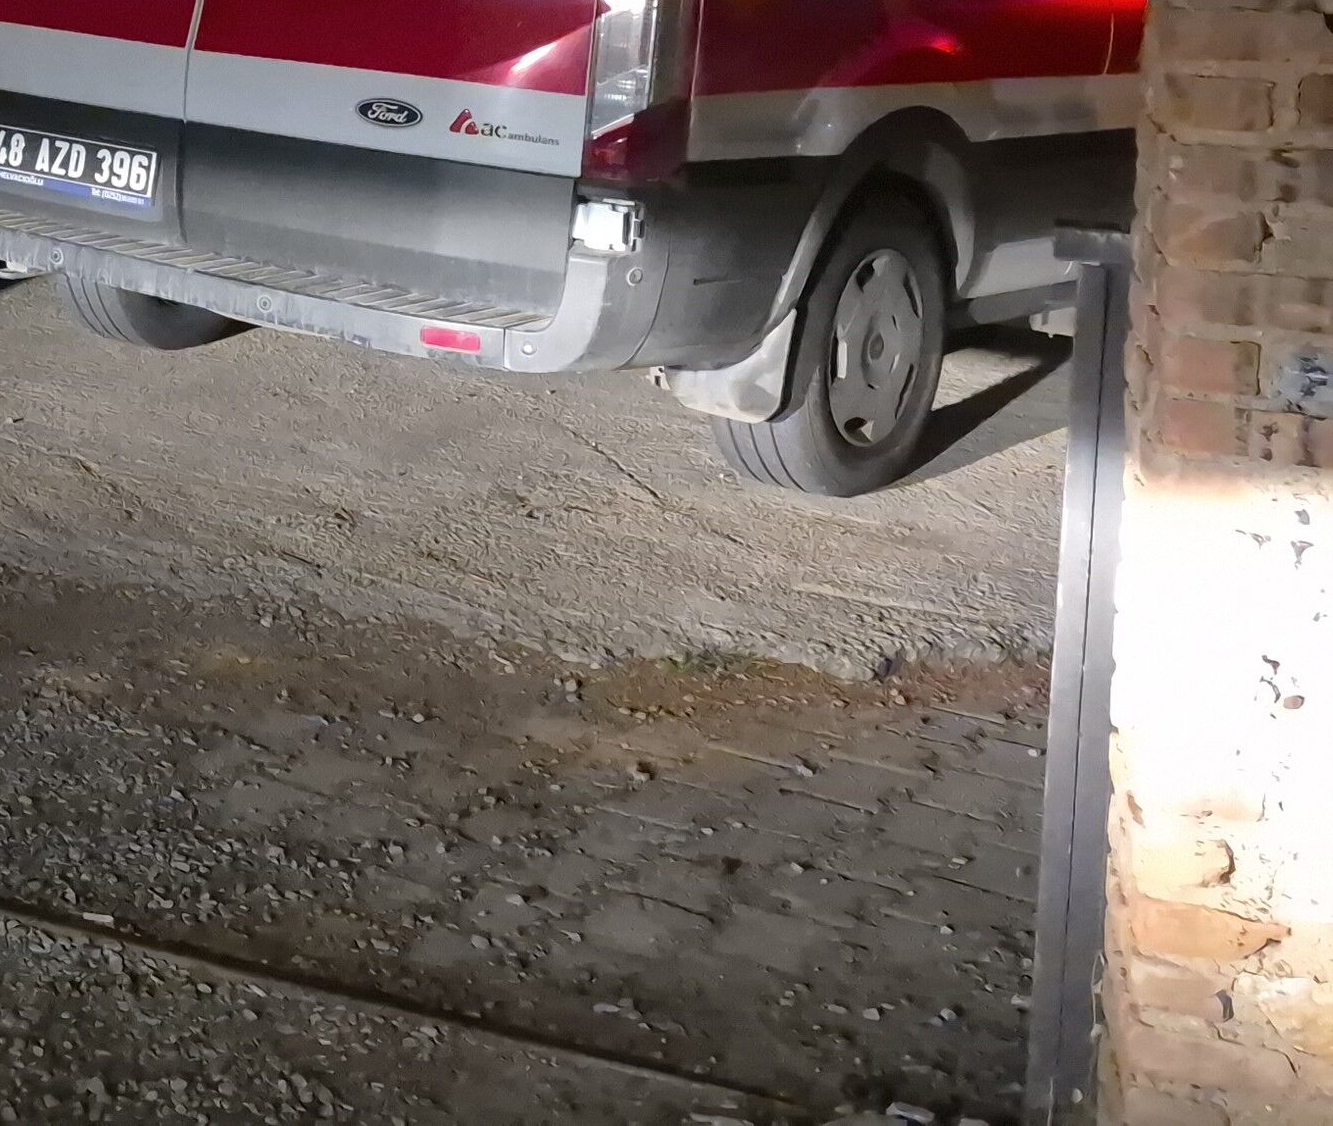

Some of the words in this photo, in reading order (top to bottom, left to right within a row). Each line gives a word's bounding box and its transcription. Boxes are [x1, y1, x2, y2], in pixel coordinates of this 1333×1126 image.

[367, 102, 409, 124] Ford
[507, 133, 560, 146] ambulans
[35, 137, 87, 179] AZD
[94, 148, 149, 192] 396
